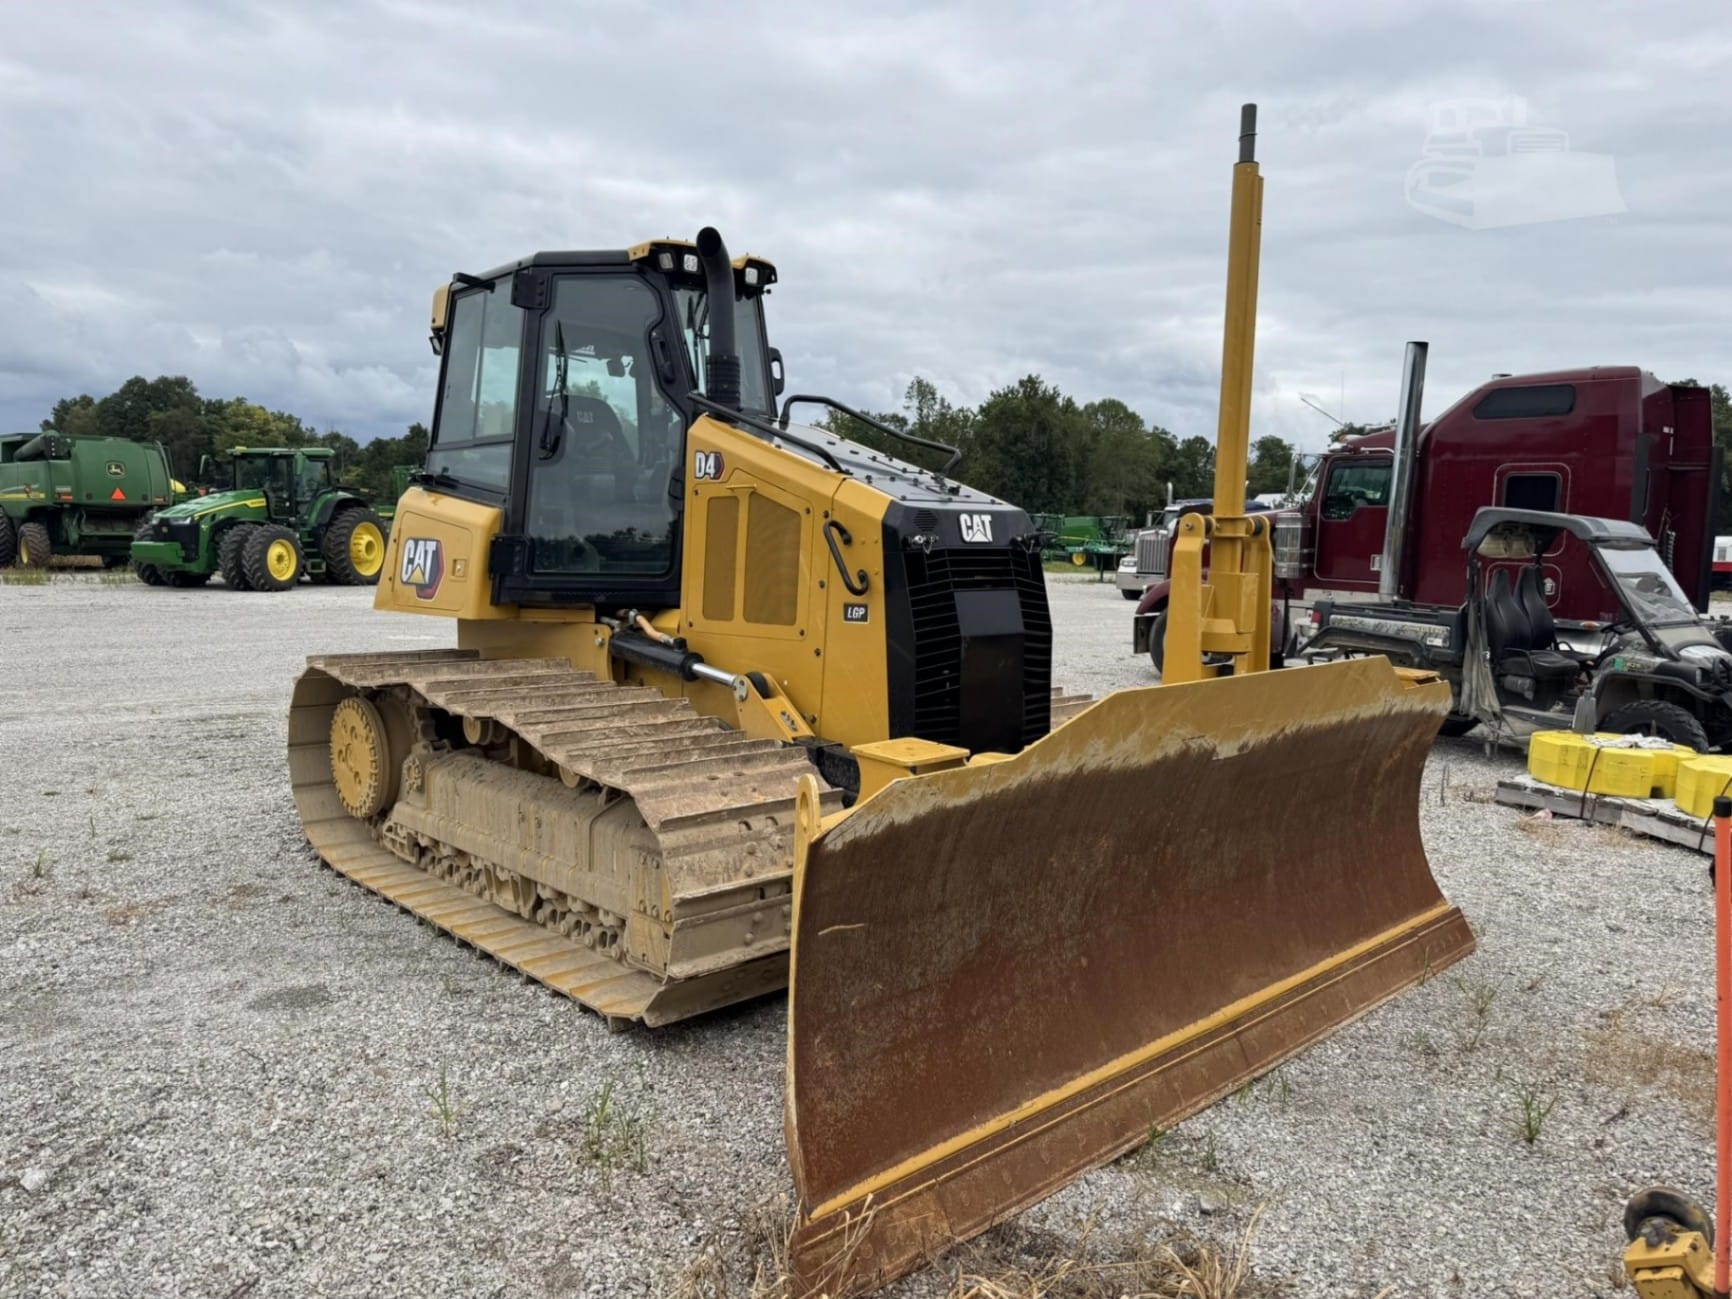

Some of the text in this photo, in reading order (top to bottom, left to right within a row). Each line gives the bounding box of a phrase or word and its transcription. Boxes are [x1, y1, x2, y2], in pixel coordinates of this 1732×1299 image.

[695, 451, 716, 479] D4
[960, 513, 993, 542] CAT
[401, 539, 437, 584] CAT
[847, 606, 865, 619] LGP
